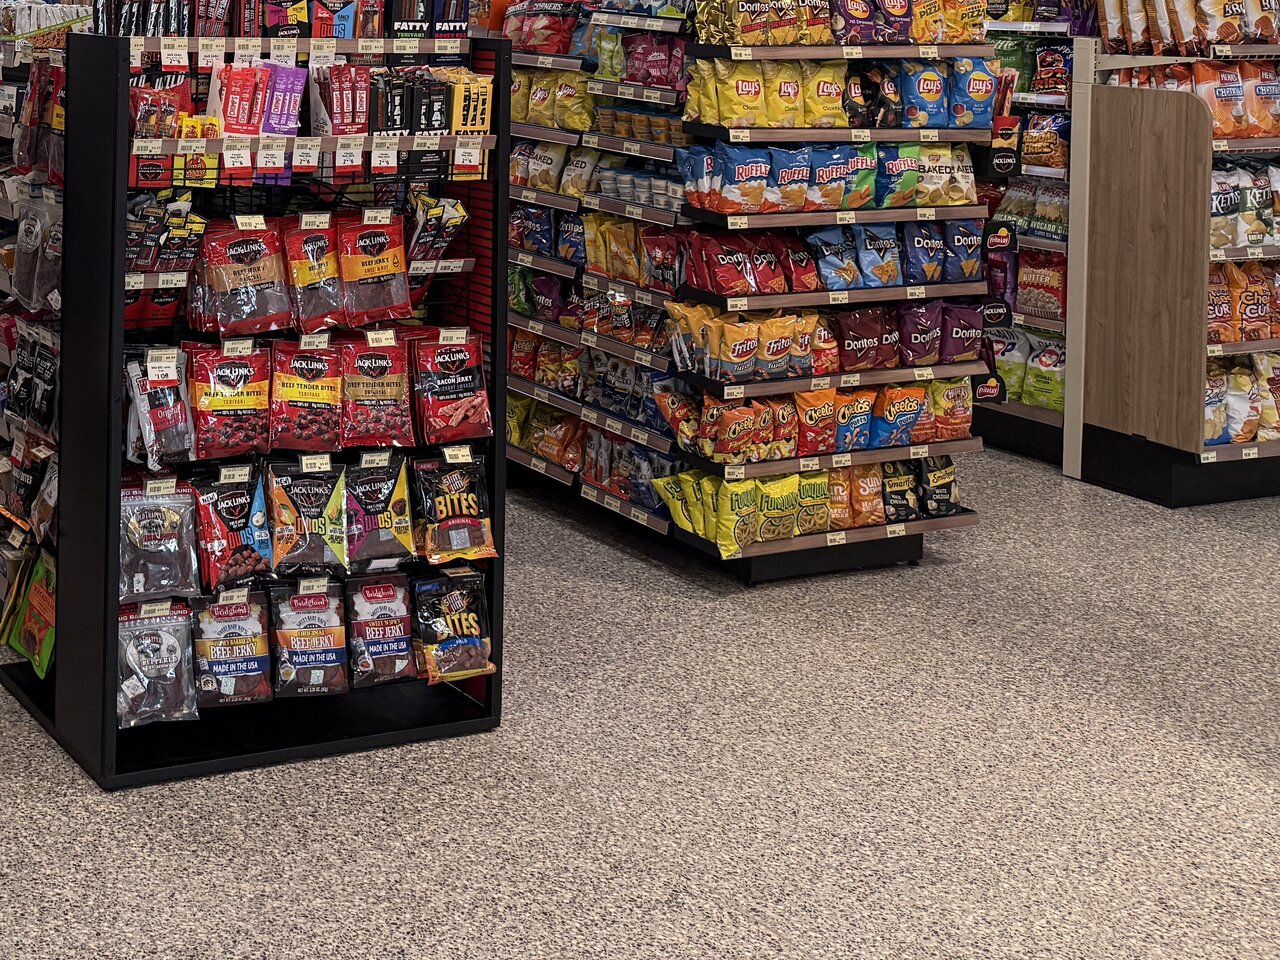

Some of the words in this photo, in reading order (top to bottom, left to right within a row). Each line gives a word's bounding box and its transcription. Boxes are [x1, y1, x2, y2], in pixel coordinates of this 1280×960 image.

[739, 1, 768, 12] Doritos
[848, 0, 868, 12] Lay's
[394, 22, 429, 31] FATTY
[436, 22, 468, 31] FATTY
[737, 79, 760, 94] Lay's
[818, 84, 841, 97] Lay's
[886, 156, 917, 173] RUFFLES
[867, 238, 895, 250] Doritos
[915, 237, 943, 249] Doritos
[732, 340, 757, 357] Fritos
[767, 337, 791, 355] Fritos
[845, 338, 878, 350] Doritos
[290, 359, 308, 368] JACK
[309, 360, 328, 370] LINK'S
[837, 400, 870, 422] Cheetos
[886, 398, 918, 420] Cheetos
[436, 494, 478, 518] BITES
[294, 598, 326, 608] Bridgford
[213, 606, 248, 616] Bridgford
[366, 627, 383, 639] BEEF
[384, 625, 404, 637] JERKY
[291, 638, 310, 648] BEEF
[311, 634, 334, 647] JERKY
[210, 646, 230, 659] BEEF
[231, 643, 256, 656] JERKY
[213, 664, 228, 672] MADE
[247, 662, 258, 670] USA
